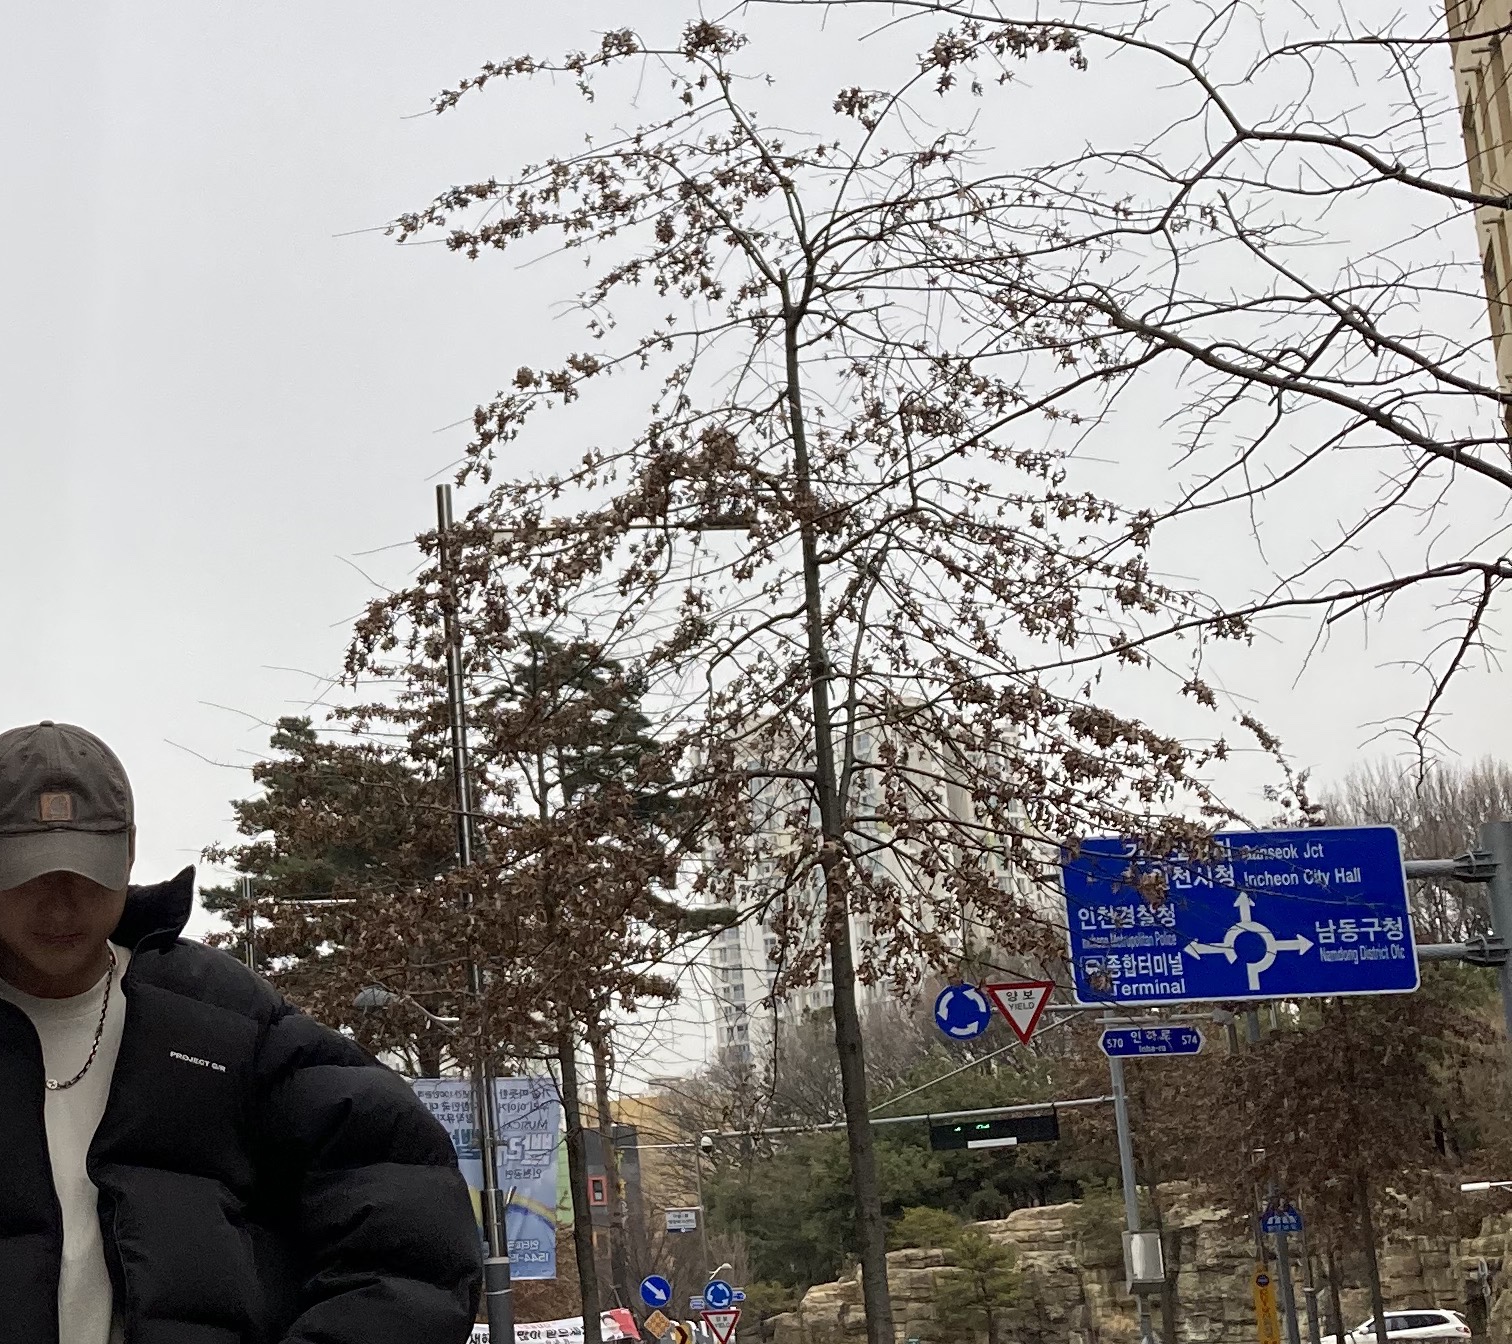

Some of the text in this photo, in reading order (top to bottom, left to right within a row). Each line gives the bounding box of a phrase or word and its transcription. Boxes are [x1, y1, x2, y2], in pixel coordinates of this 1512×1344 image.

[1303, 843, 1325, 860] Jct
[1244, 870, 1300, 888] Incheon
[1304, 869, 1331, 888] City
[1334, 867, 1362, 884] Hall
[1315, 916, 1405, 944] 남동구청
[1106, 952, 1184, 979] 종합터미널
[1112, 978, 1186, 997] Terminal
[1007, 1000, 1035, 1011] YIELD
[169, 1051, 210, 1067] PROJECT
